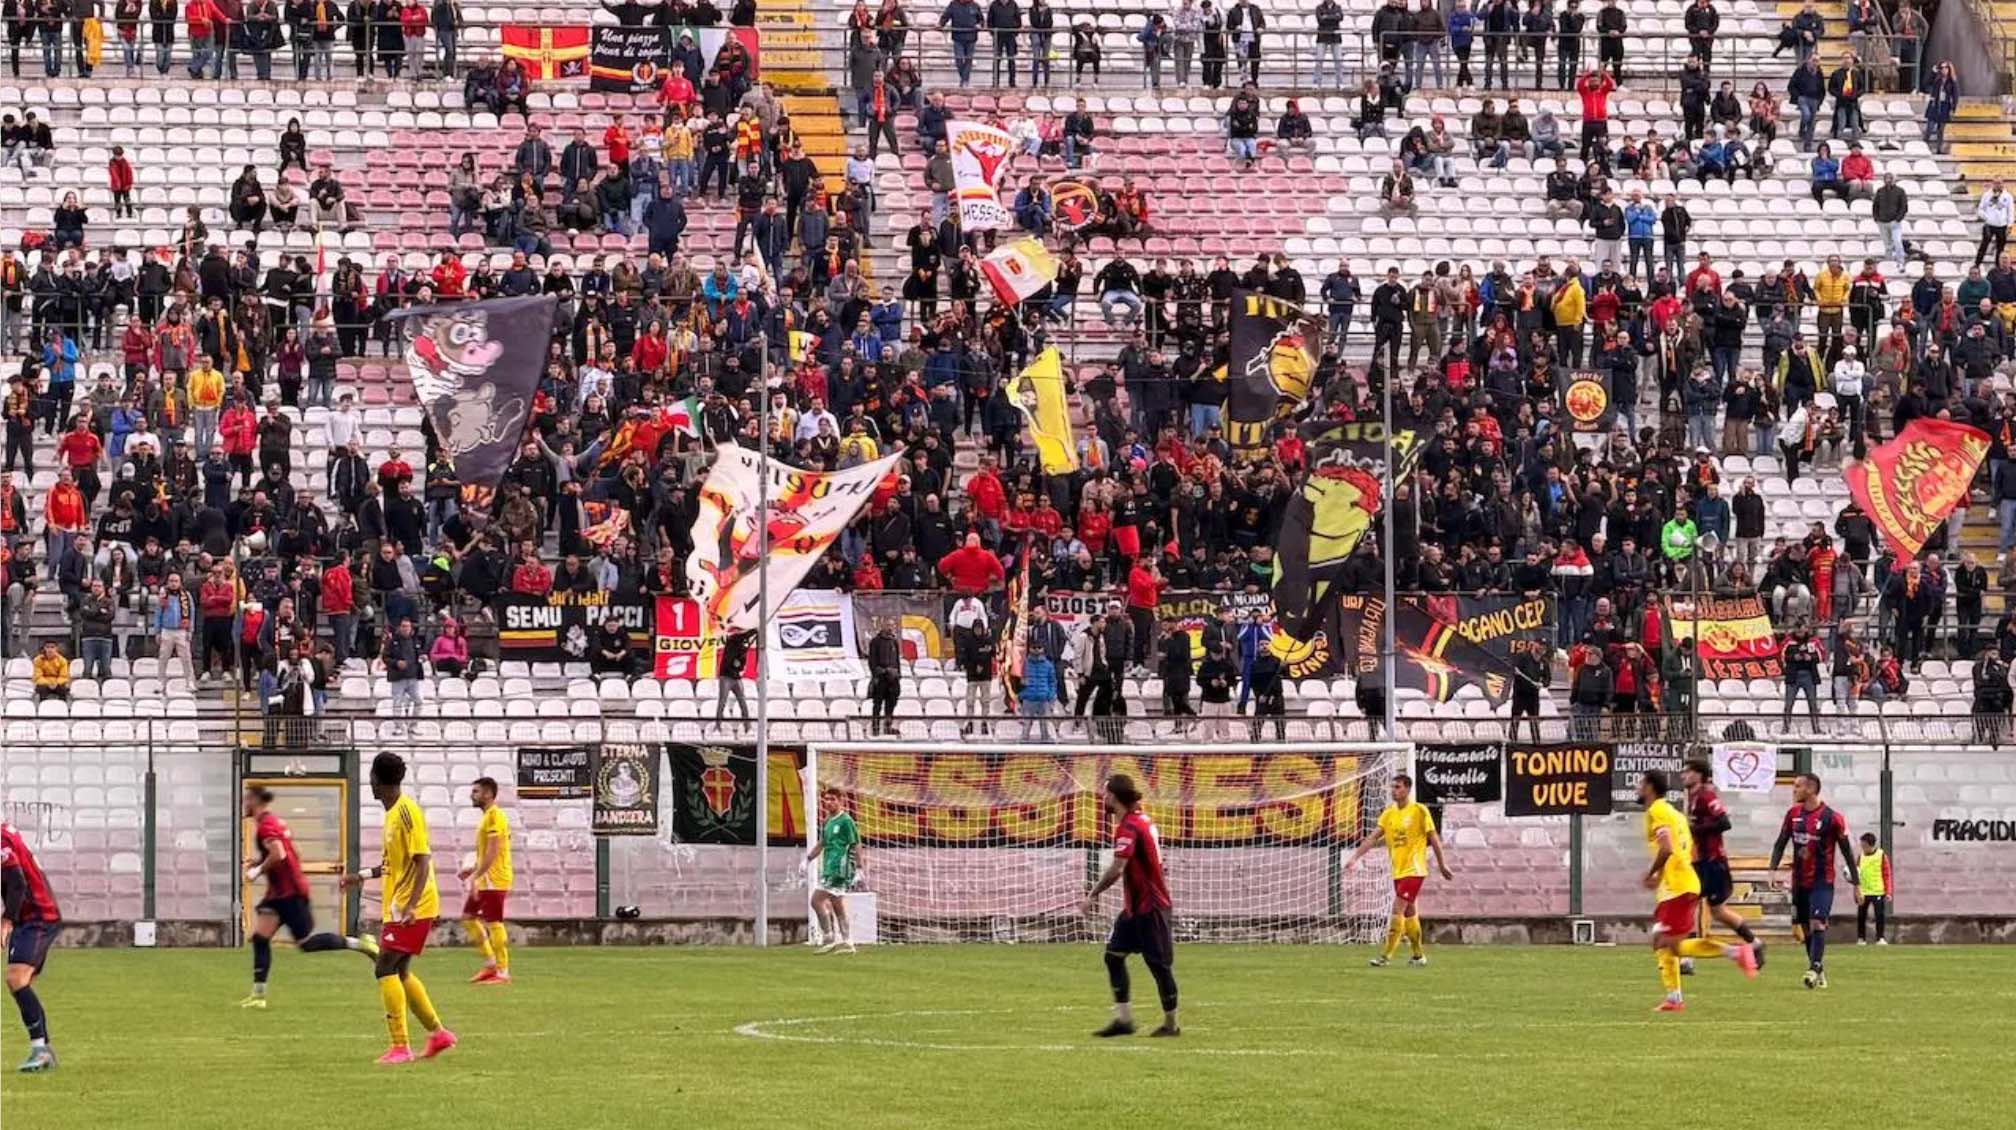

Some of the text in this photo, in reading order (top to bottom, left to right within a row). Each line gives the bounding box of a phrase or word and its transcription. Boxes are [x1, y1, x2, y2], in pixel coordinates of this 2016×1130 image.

[1221, 593, 1269, 606] A MODO
[506, 605, 643, 628] SEMU PACCI
[1514, 600, 1546, 630] CEP
[601, 744, 649, 757] ETERNA
[1617, 743, 1668, 756] MARESCA
[1512, 750, 1608, 776] TONINO
[1533, 782, 1588, 806] VIVE
